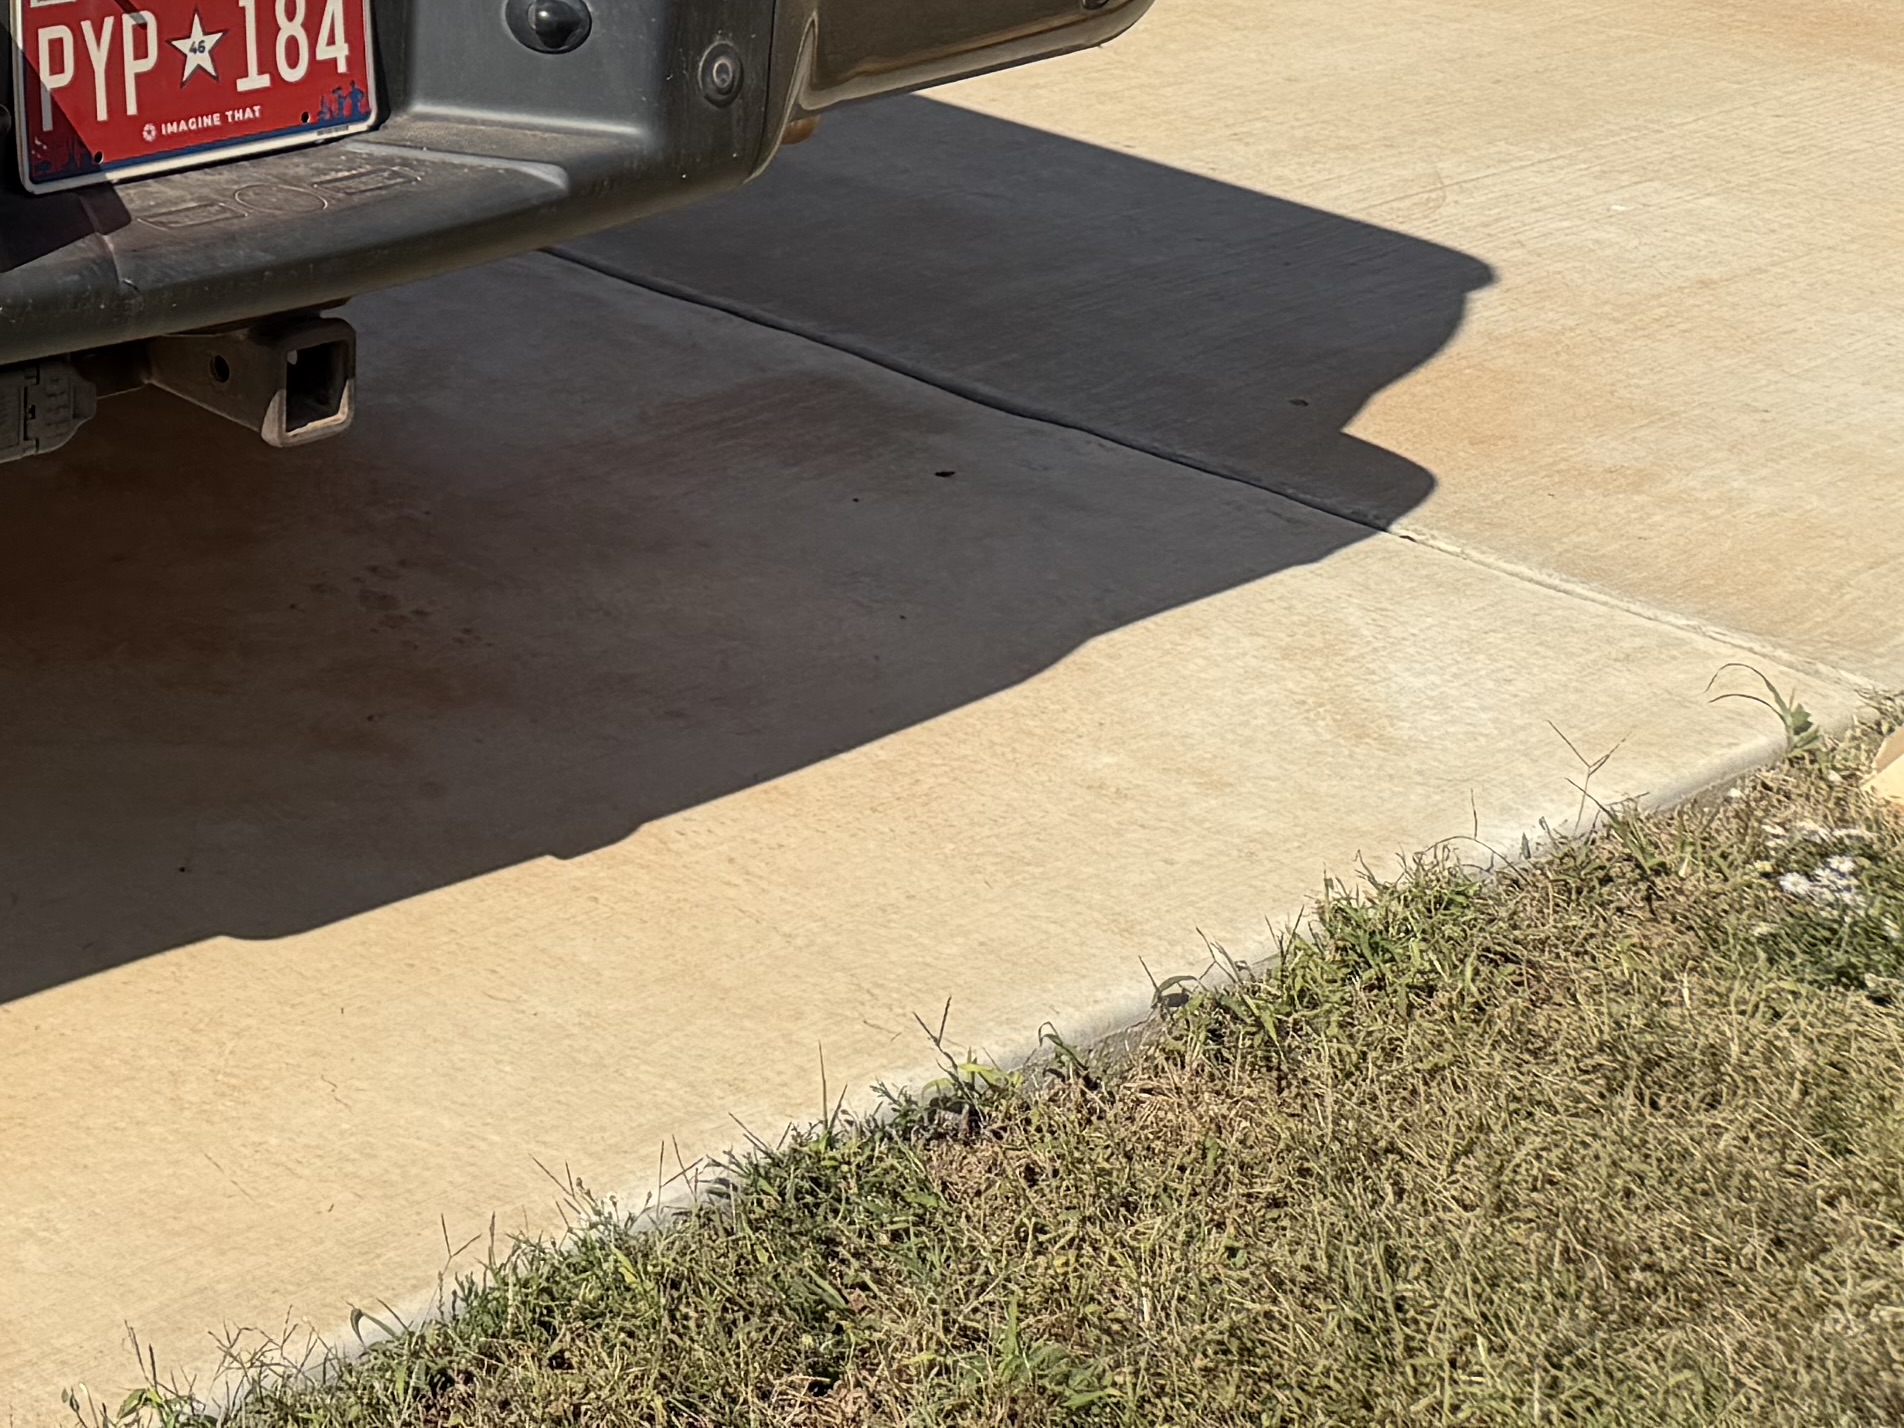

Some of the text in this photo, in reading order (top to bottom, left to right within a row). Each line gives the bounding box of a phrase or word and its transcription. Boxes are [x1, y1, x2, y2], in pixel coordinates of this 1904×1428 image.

[188, 39, 206, 55] 46
[37, 10, 159, 132] PYP
[161, 105, 261, 136] IMAGINE THAT
